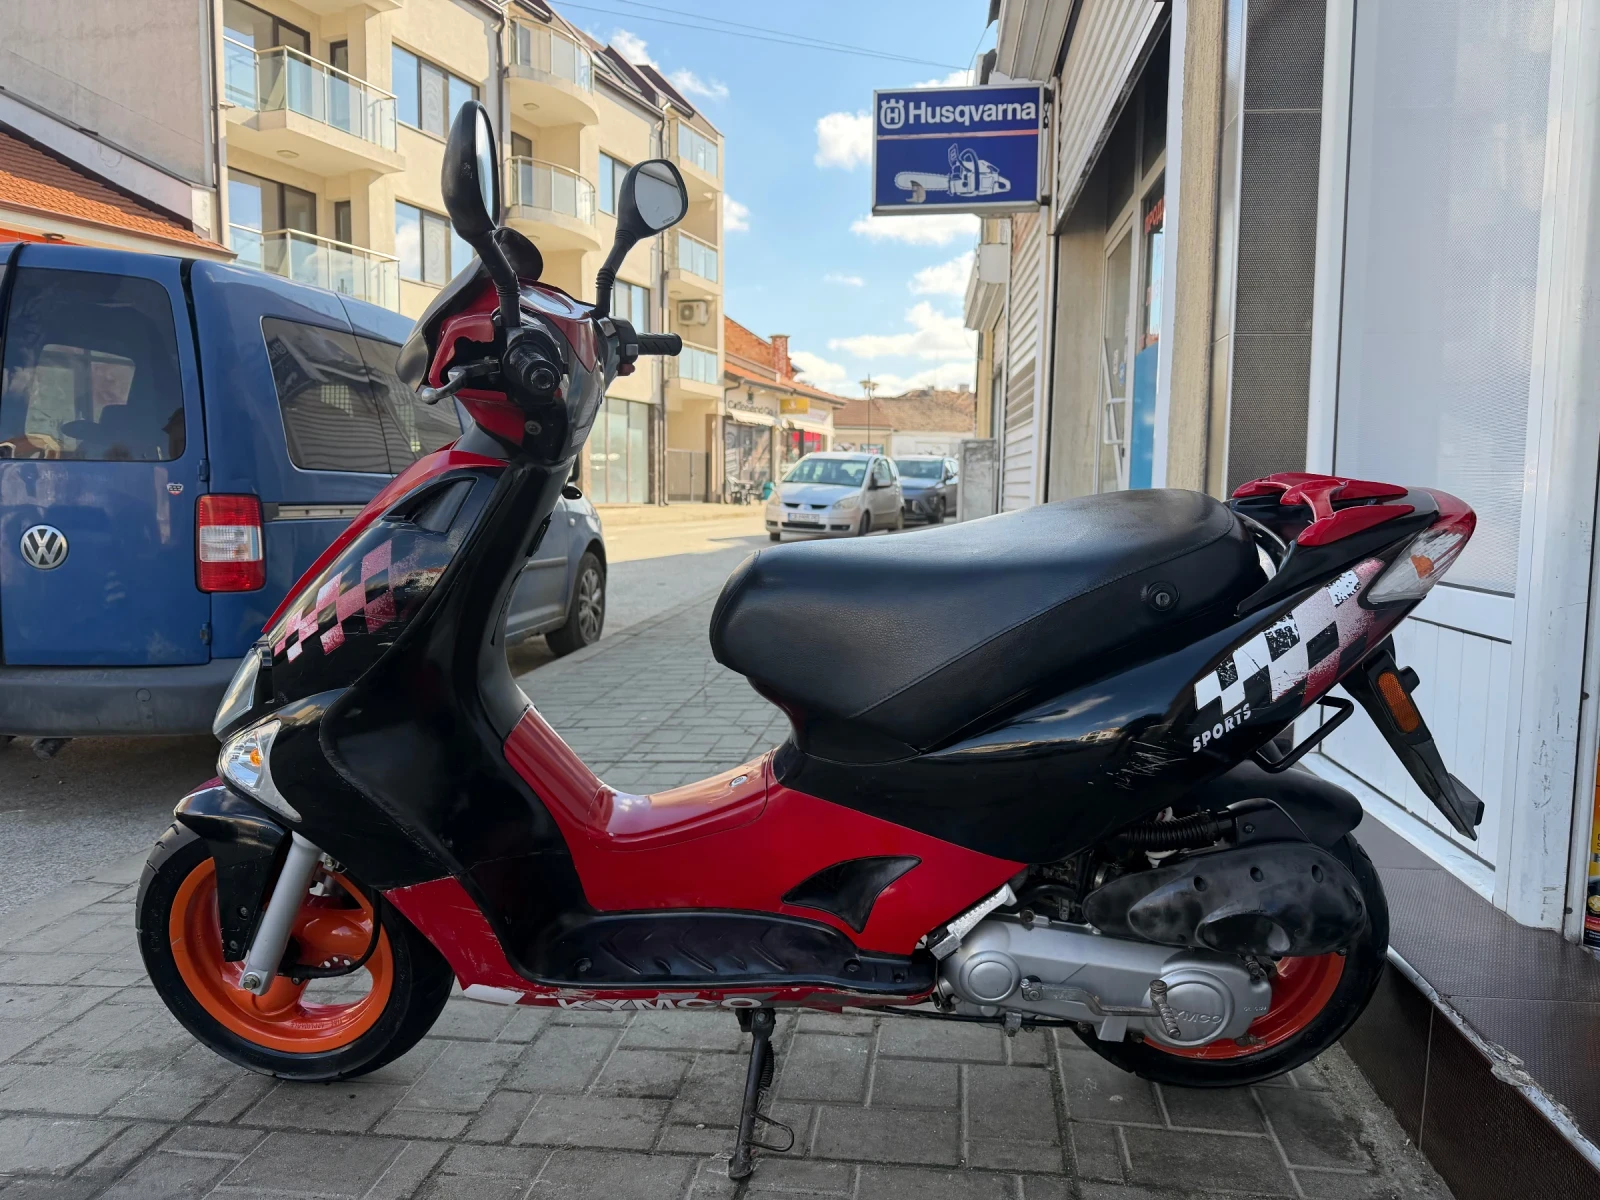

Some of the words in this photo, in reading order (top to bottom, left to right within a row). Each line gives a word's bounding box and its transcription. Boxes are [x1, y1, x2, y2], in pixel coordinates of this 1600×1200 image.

[908, 101, 1036, 127] Husqvarna
[1193, 703, 1251, 753] SPORTS
[557, 997, 763, 1011] KYMCO
[1171, 1007, 1222, 1024] YMCO
